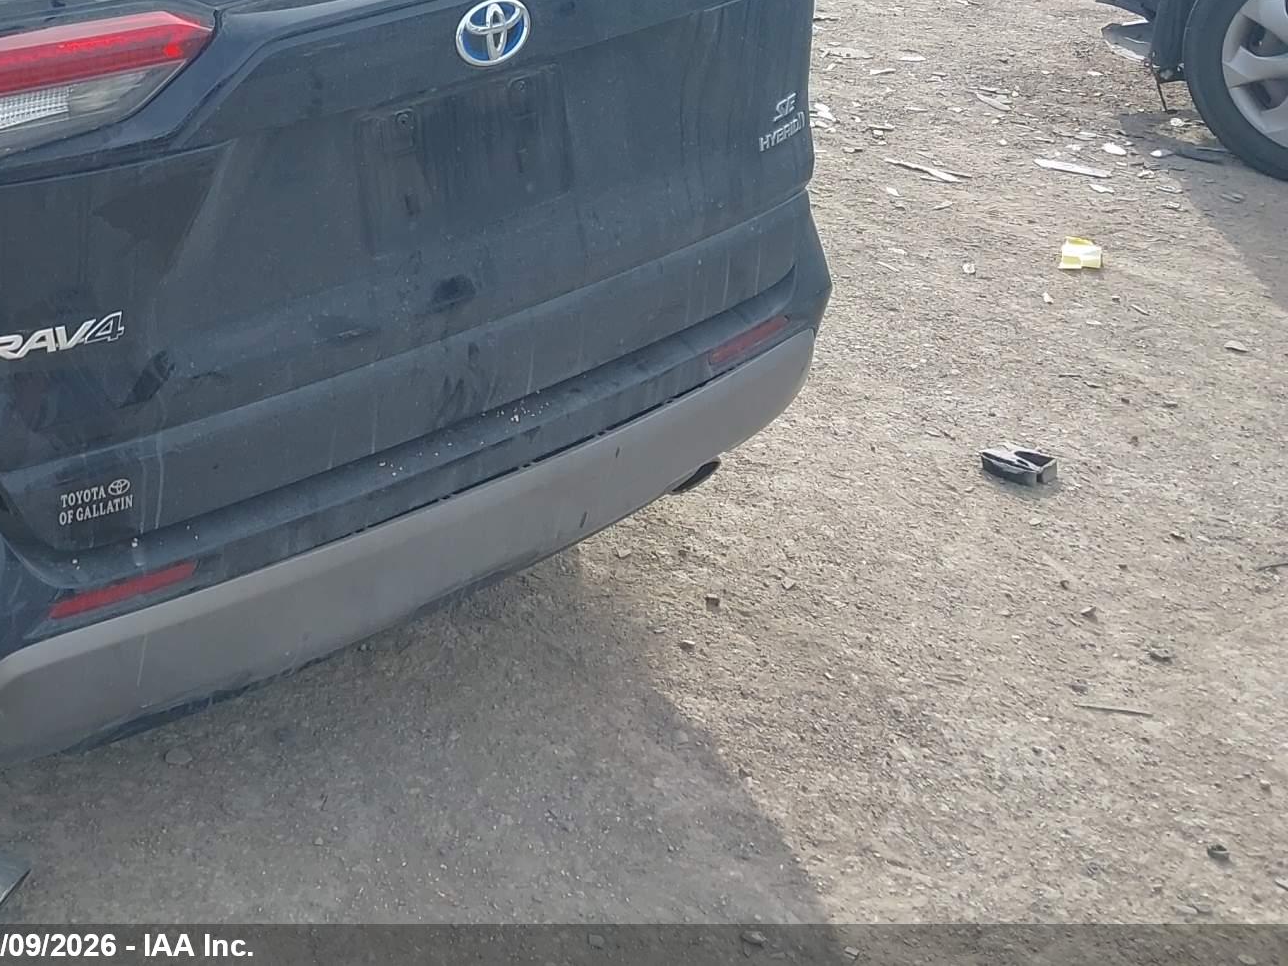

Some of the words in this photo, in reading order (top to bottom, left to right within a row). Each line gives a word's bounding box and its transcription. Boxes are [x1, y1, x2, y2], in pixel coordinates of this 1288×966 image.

[59, 510, 74, 525] OF
[76, 495, 134, 521] GALLATIN
[61, 487, 106, 508] TOYOTA
